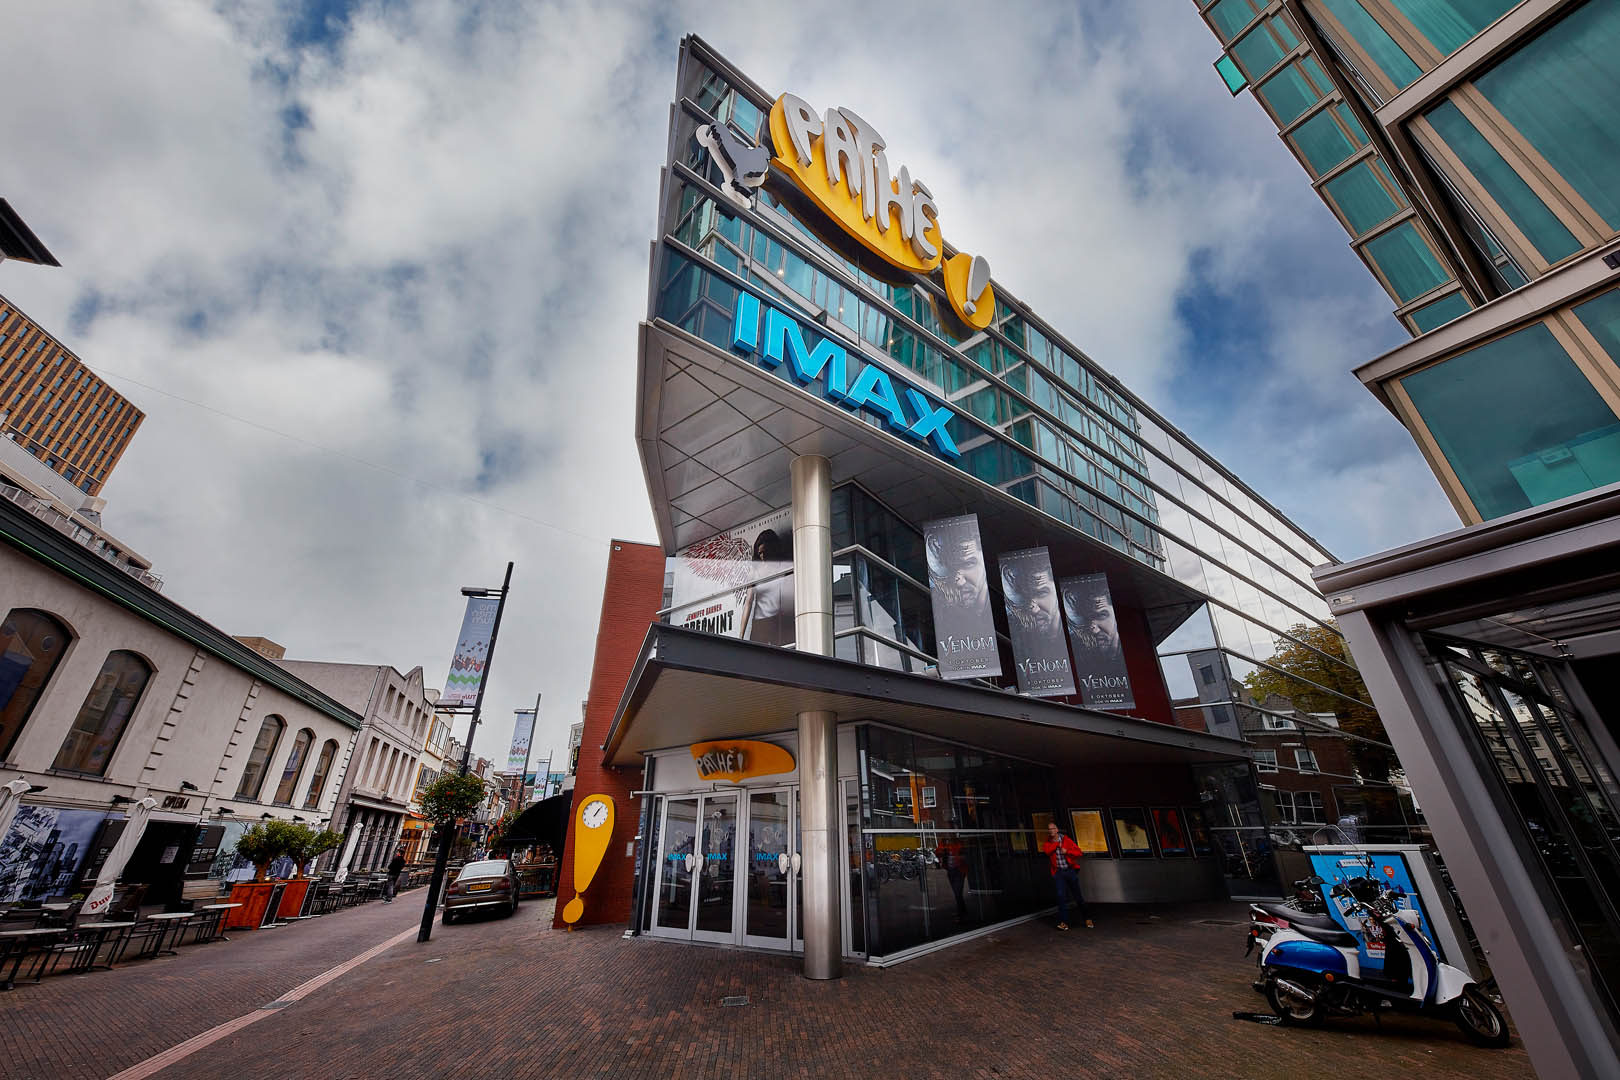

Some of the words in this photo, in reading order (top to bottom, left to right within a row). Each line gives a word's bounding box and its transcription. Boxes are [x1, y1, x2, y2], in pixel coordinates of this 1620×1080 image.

[734, 290, 961, 459] IMAX
[939, 635, 996, 656] VENOM
[1018, 658, 1069, 677] VENOM
[1080, 674, 1129, 691] VENOM
[667, 852, 687, 861] IMAX
[707, 852, 728, 861] IMAX
[756, 852, 779, 861] IMAX
